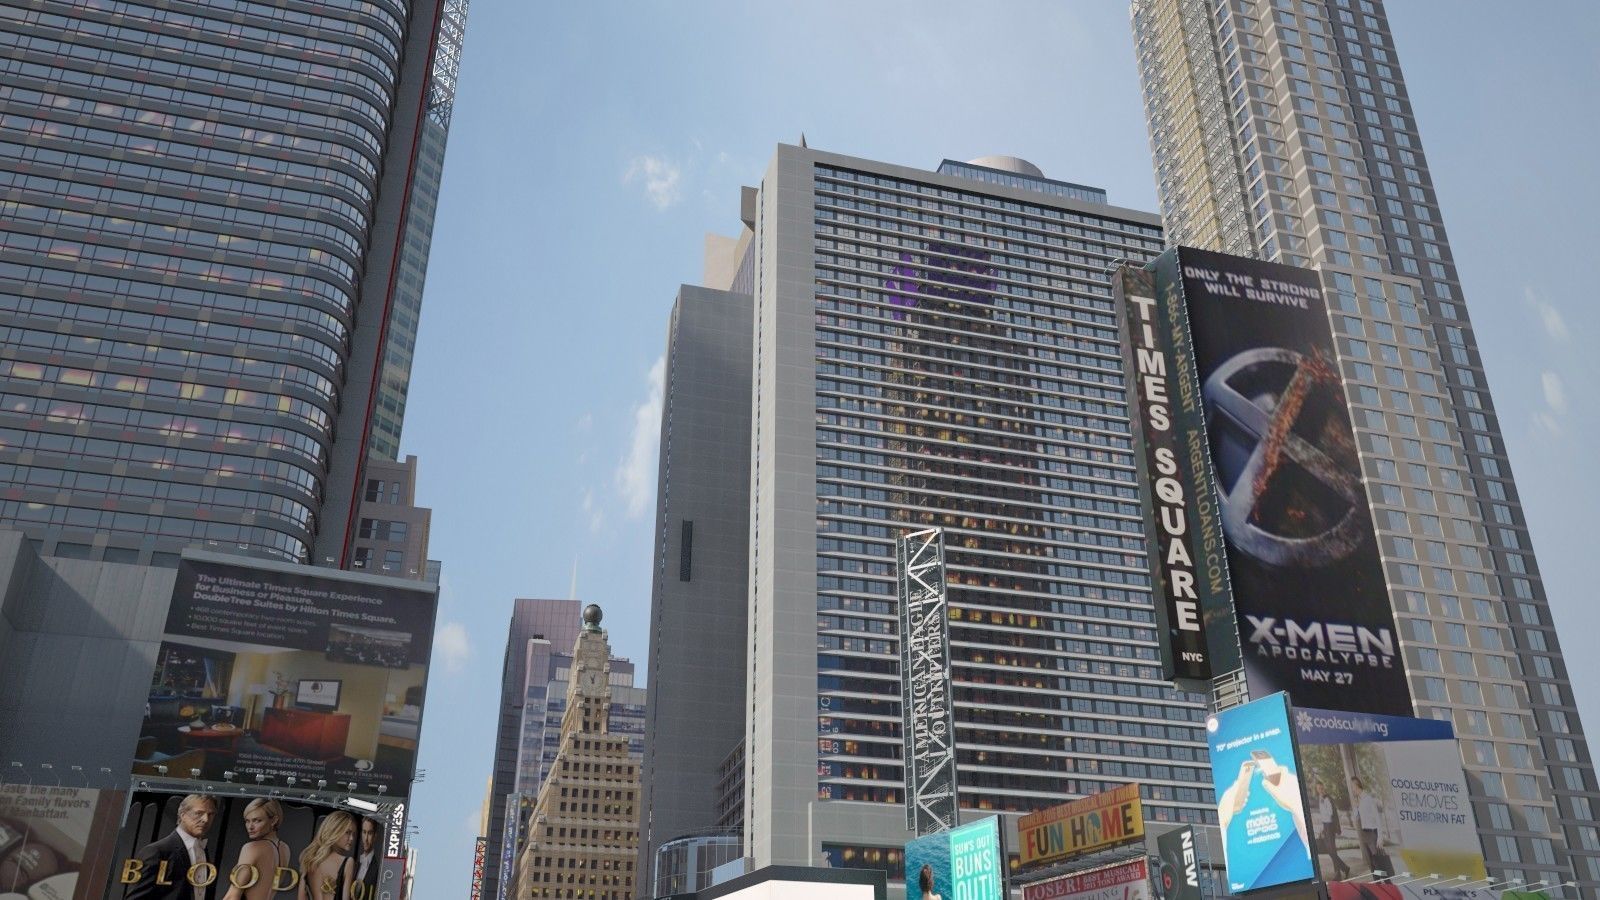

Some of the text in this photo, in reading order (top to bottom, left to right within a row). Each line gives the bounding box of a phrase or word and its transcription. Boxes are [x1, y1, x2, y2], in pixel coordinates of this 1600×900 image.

[1184, 266, 1321, 300] ONLY THE STRONG
[1204, 282, 1309, 309] WILL SURVIVE
[1130, 296, 1200, 632] TIMES SQUARE
[1186, 429, 1223, 595] ARGENTLOANS.COM
[195, 582, 211, 591] for
[211, 584, 256, 597] Business
[270, 592, 314, 605] Pleasure.
[198, 574, 383, 605] The Ultimate Times Square Experience
[193, 591, 397, 624] DoubleTree Suites by Hilton Times Square.
[1245, 615, 1396, 656] X-MEN
[1181, 651, 1204, 663] NYC
[1257, 644, 1393, 669] APOCALYPSE
[1300, 668, 1354, 685] MAY 27
[912, 652, 930, 763] AMERICAN
[1391, 778, 1459, 793] COOLSCULPTING
[1401, 792, 1459, 810] REMOVES
[1026, 803, 1135, 860] FUN HOME
[1400, 811, 1466, 825] STUBBORN FAT
[954, 834, 990, 856] SUN'S OUT
[955, 849, 992, 880] BUNS
[1181, 831, 1198, 887] NEW
[120, 858, 299, 892] BLOOD
[319, 876, 337, 895] &
[956, 873, 994, 900] OUT!
[1026, 878, 1081, 900] LOSER!
[1083, 874, 1100, 883] BEST
[1098, 878, 1115, 887] TONY
[1116, 872, 1140, 884] AWARD
